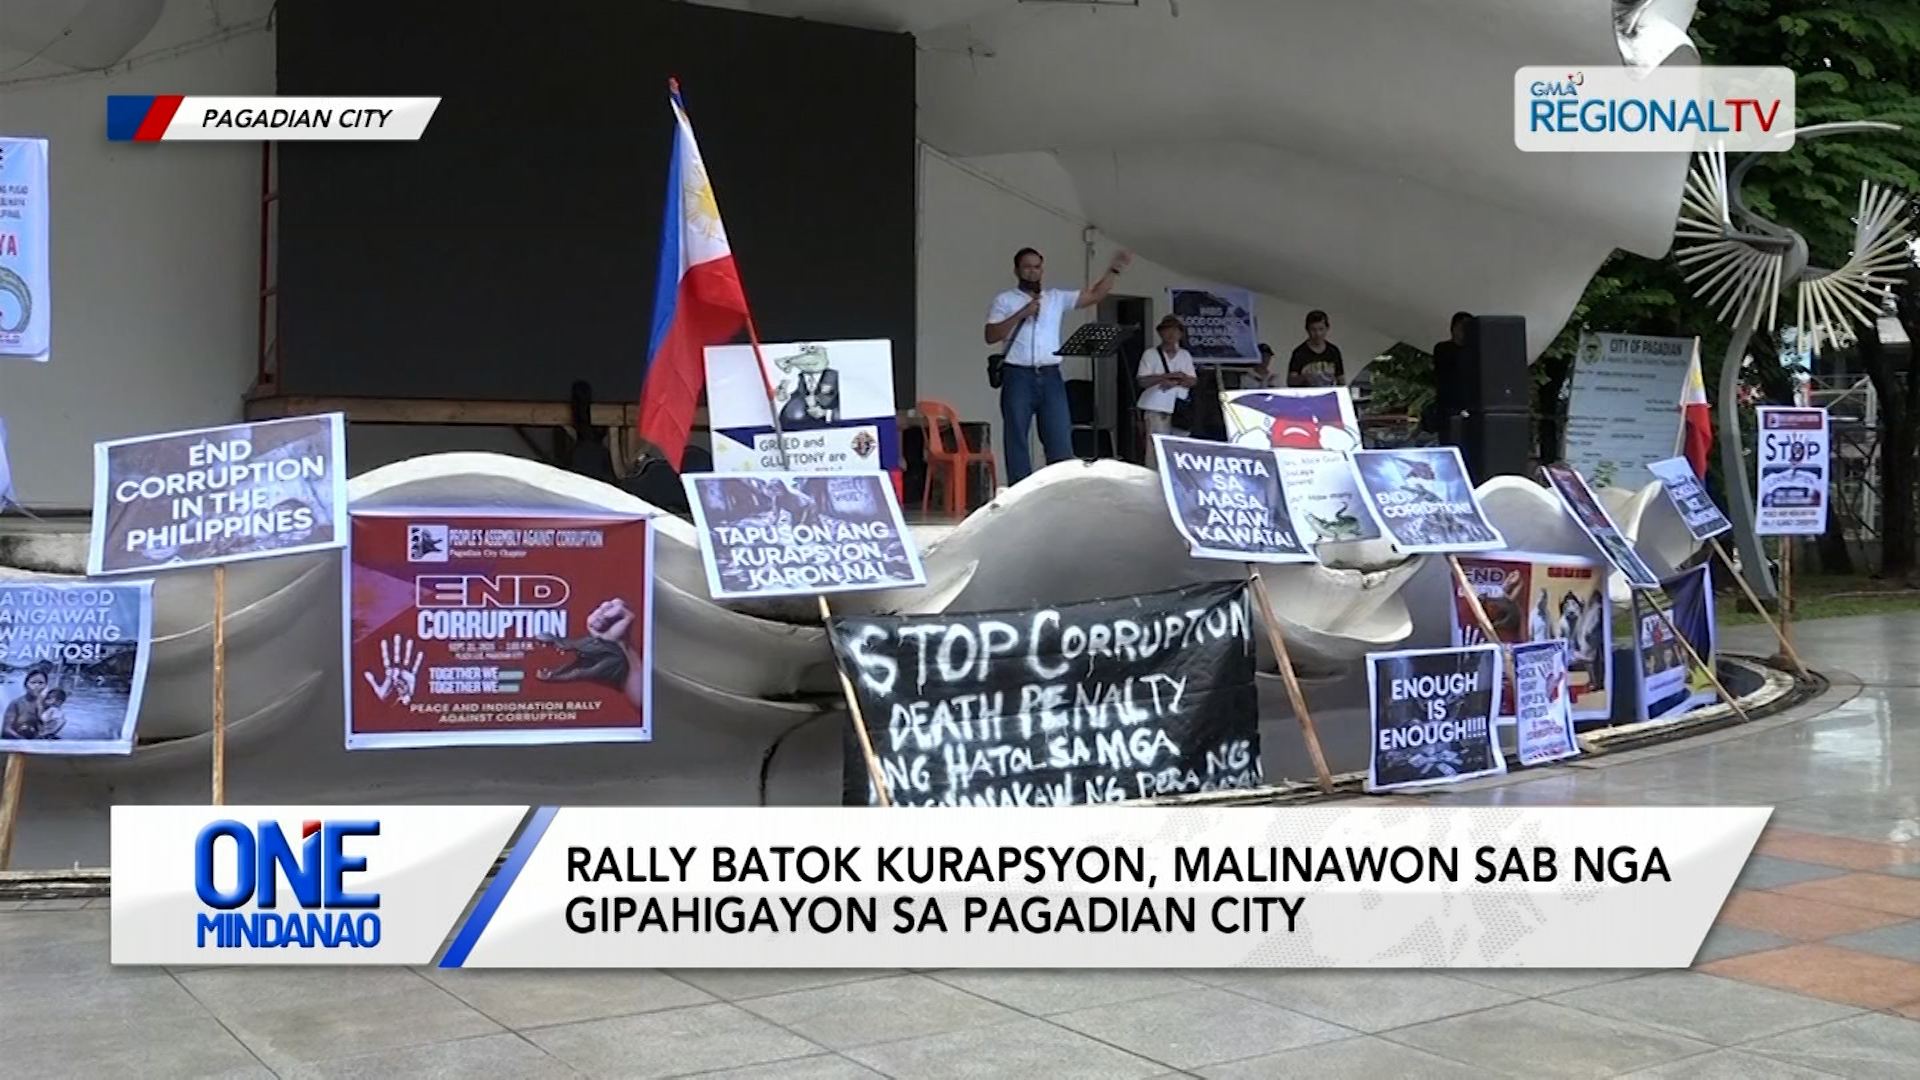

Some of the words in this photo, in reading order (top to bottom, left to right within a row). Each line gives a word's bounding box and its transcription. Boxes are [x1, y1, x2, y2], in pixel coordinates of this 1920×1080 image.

[189, 439, 251, 466] END
[803, 436, 825, 448] and
[1765, 433, 1820, 461] STOP
[829, 453, 847, 462] are
[1174, 452, 1270, 478] KWARTA
[116, 455, 324, 503] CORRUPTION
[1212, 472, 1245, 492] SA
[172, 501, 202, 520] IN
[209, 487, 271, 515] THE
[1197, 489, 1264, 510] MASA
[1208, 507, 1268, 527] AYAW
[126, 507, 313, 552] PHILIPPINES
[714, 525, 832, 545] TAPUSON
[837, 521, 890, 541] ANG
[1192, 525, 1296, 547] KAWATA!
[843, 561, 887, 581] NA!
[20, 589, 115, 606] TUNGOD
[415, 575, 571, 608] END
[71, 624, 121, 642] ANG
[417, 609, 567, 640] CORRUPTION
[848, 619, 1019, 697] STOP
[1027, 592, 1251, 680] CORRUPTION
[429, 667, 481, 680] TOGETHER
[482, 667, 500, 680] WE
[1391, 671, 1478, 700] ENOUGH
[429, 682, 481, 694] TOGETHER
[482, 682, 500, 694] WE
[410, 703, 450, 713] PEACE
[452, 703, 479, 713] AND
[482, 702, 562, 712] INDIGNATION
[566, 701, 602, 711] RALLY
[439, 713, 492, 724] AGAINST
[496, 712, 577, 723] CORRUPTION
[889, 691, 1003, 751] DEATH
[1019, 673, 1188, 738] PENALTY
[1427, 698, 1447, 720] IS
[1380, 717, 1487, 750] ENOUGH!!!!
[943, 742, 1047, 793] HATOL
[1048, 735, 1091, 770] SA
[1096, 727, 1181, 770] MGA
[1136, 767, 1200, 800] PERA
[1206, 740, 1250, 775] NG
